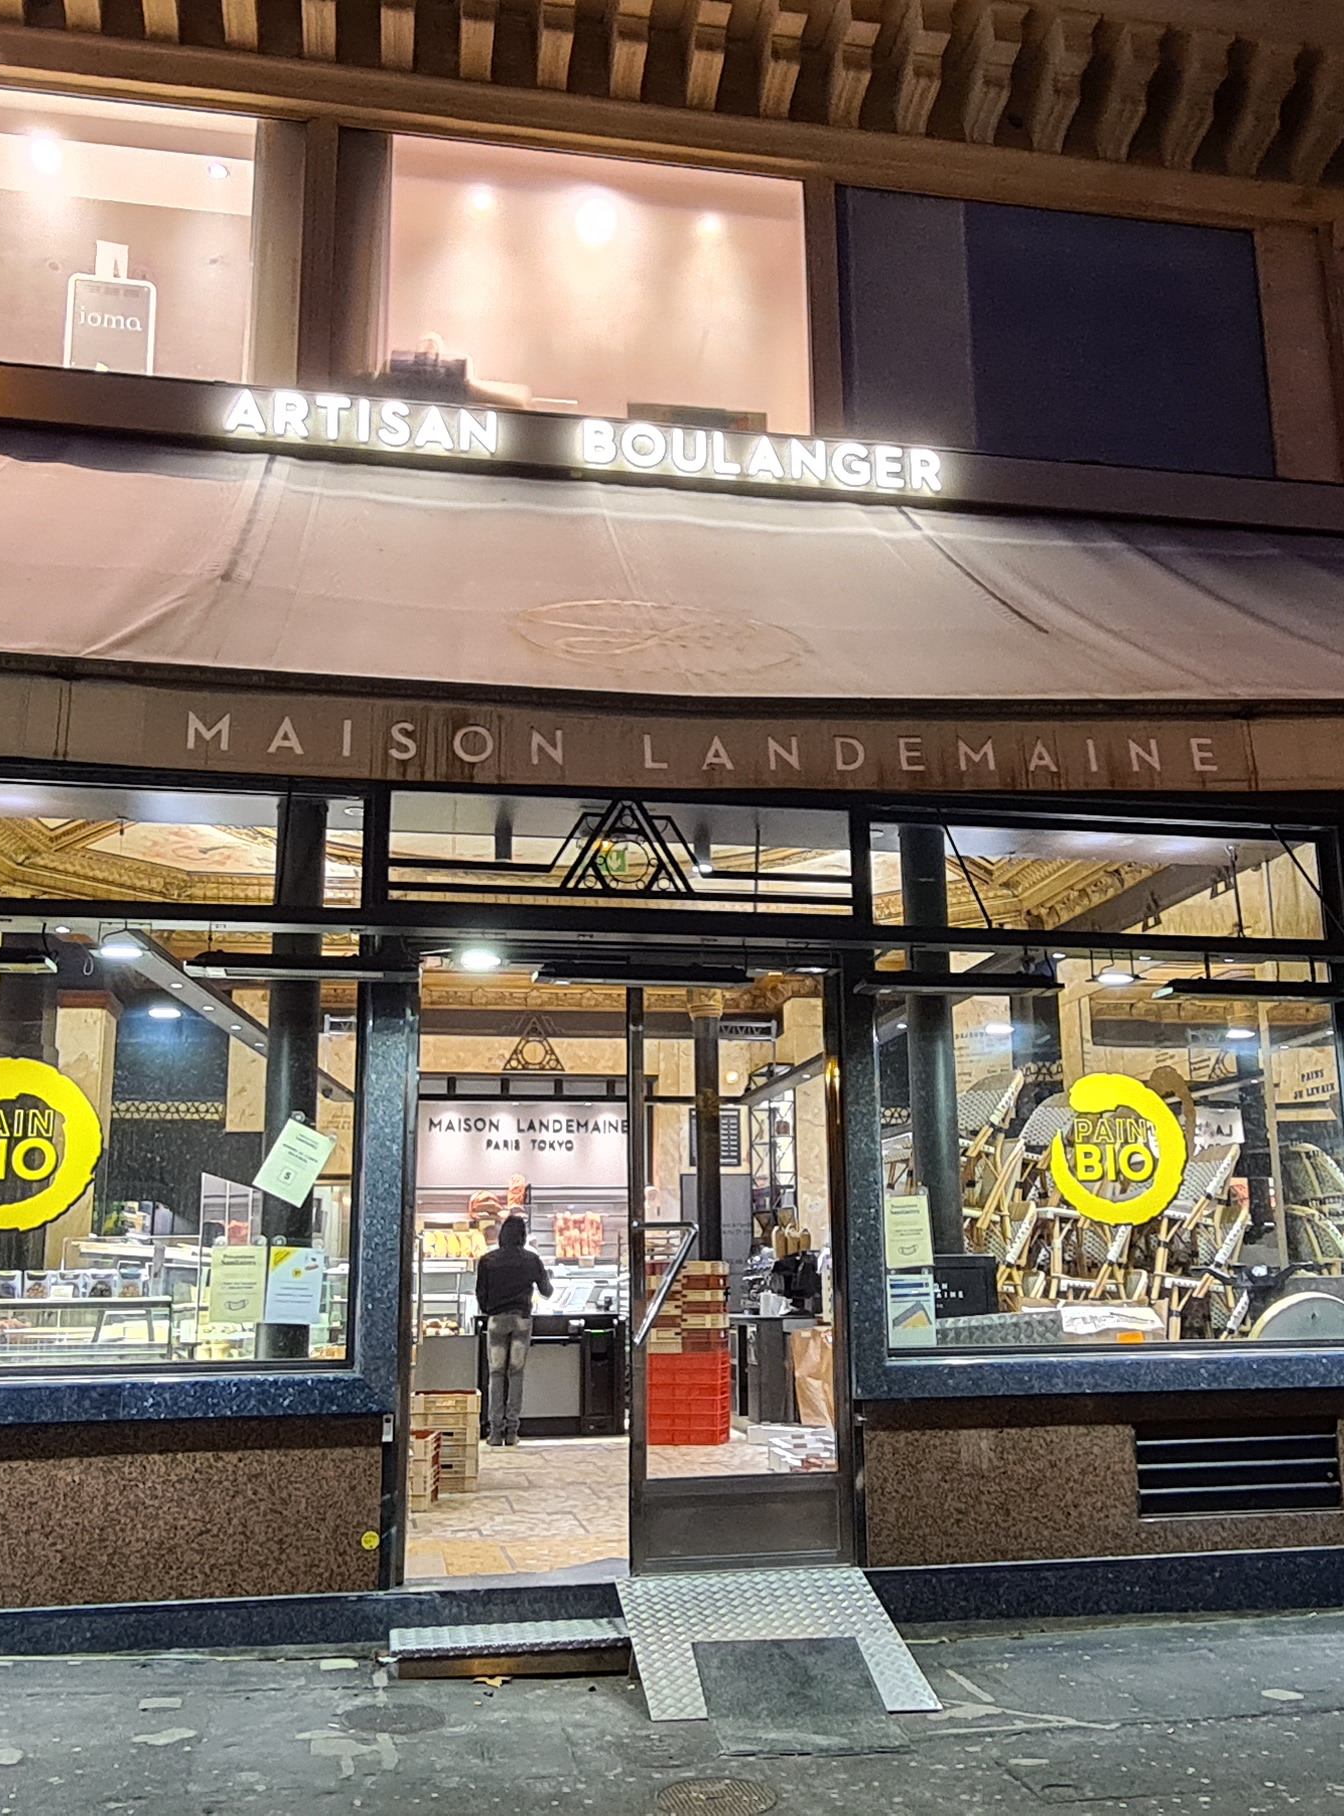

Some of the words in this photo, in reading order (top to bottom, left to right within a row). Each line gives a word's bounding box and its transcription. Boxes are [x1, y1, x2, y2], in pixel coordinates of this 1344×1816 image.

[78, 306, 144, 332] ioma
[223, 389, 499, 455] ARTISAN
[583, 418, 942, 493] BOULANGER
[186, 709, 565, 767] MAISON
[643, 731, 1221, 774] LANDEMAINE
[428, 1117, 500, 1134] MAISON
[517, 1117, 629, 1135] LANDEMAINE
[1073, 1117, 1148, 1144] PAIN
[485, 1139, 521, 1153] PARIS
[530, 1139, 575, 1153] TOKYO
[1074, 1145, 1154, 1183] BIO
